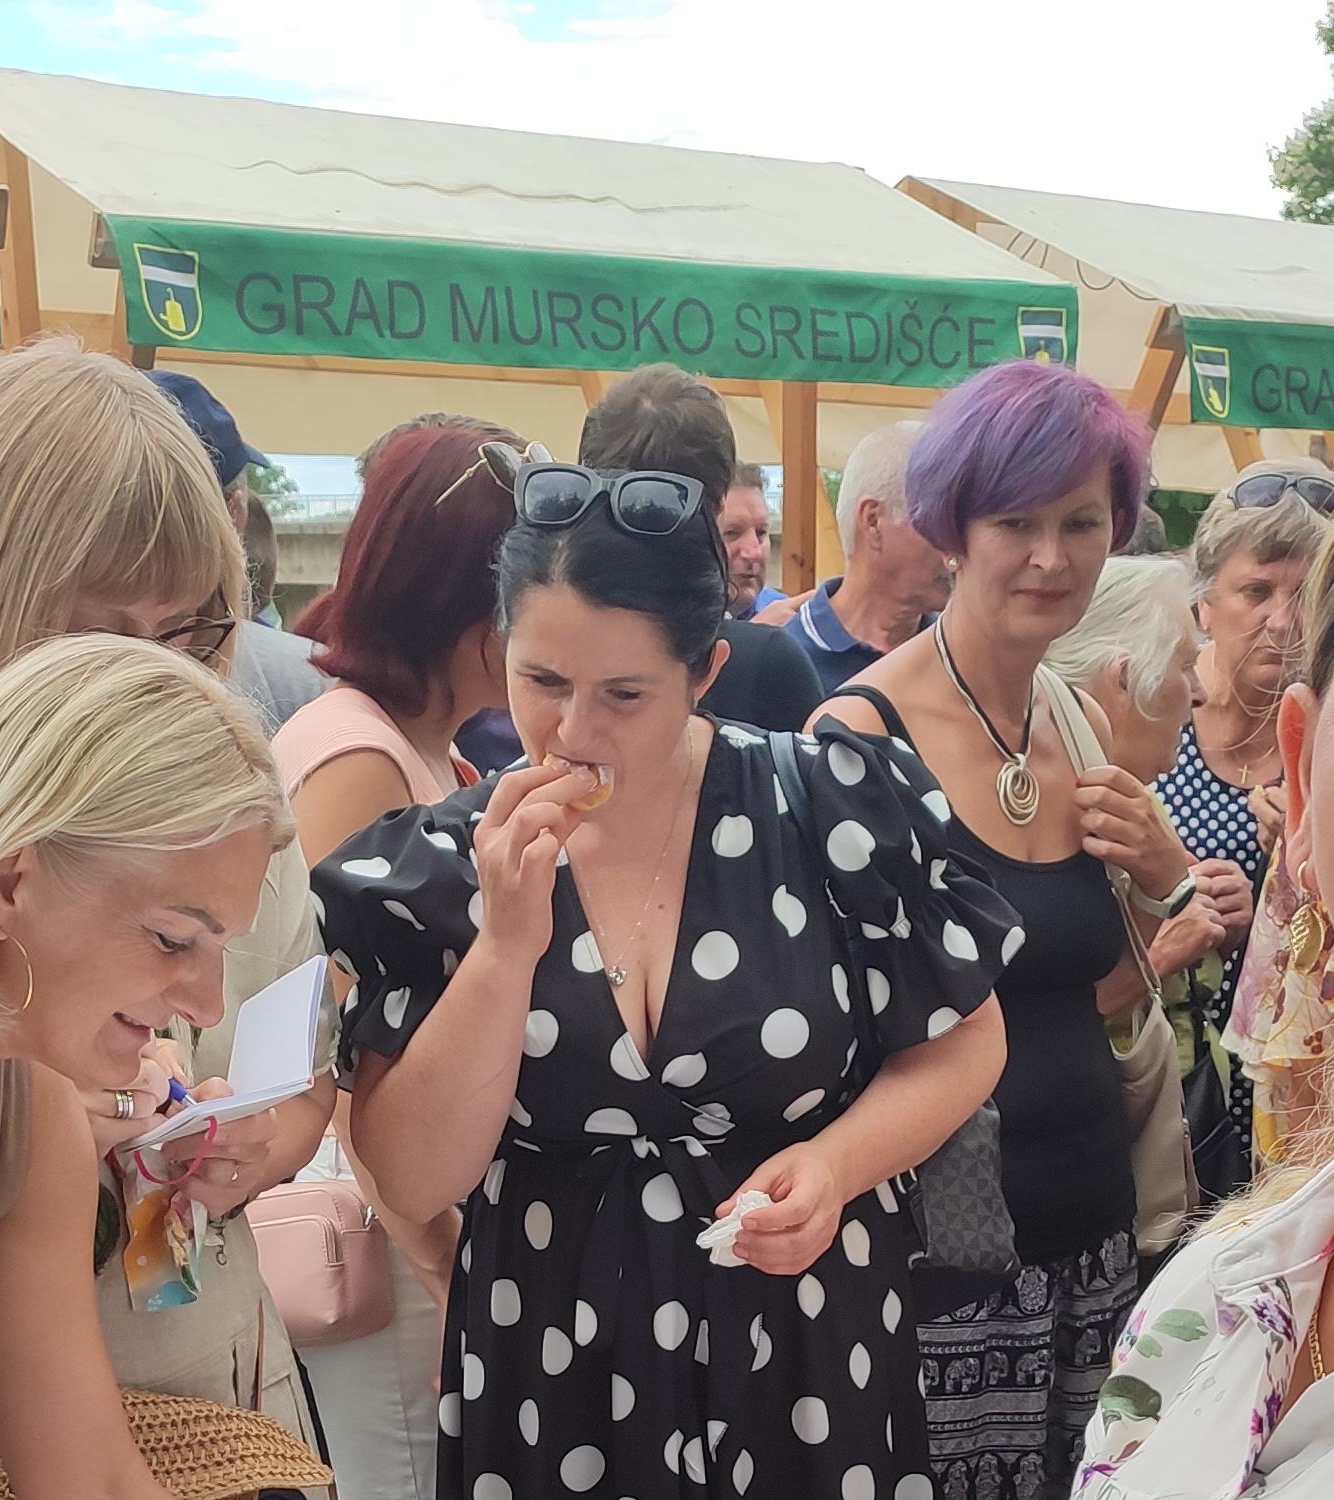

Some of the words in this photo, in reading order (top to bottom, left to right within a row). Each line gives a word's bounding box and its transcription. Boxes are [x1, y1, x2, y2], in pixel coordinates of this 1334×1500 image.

[235, 271, 427, 340] GRAD
[449, 282, 715, 356] MURSKO
[734, 299, 999, 370] SREDIŠĆE
